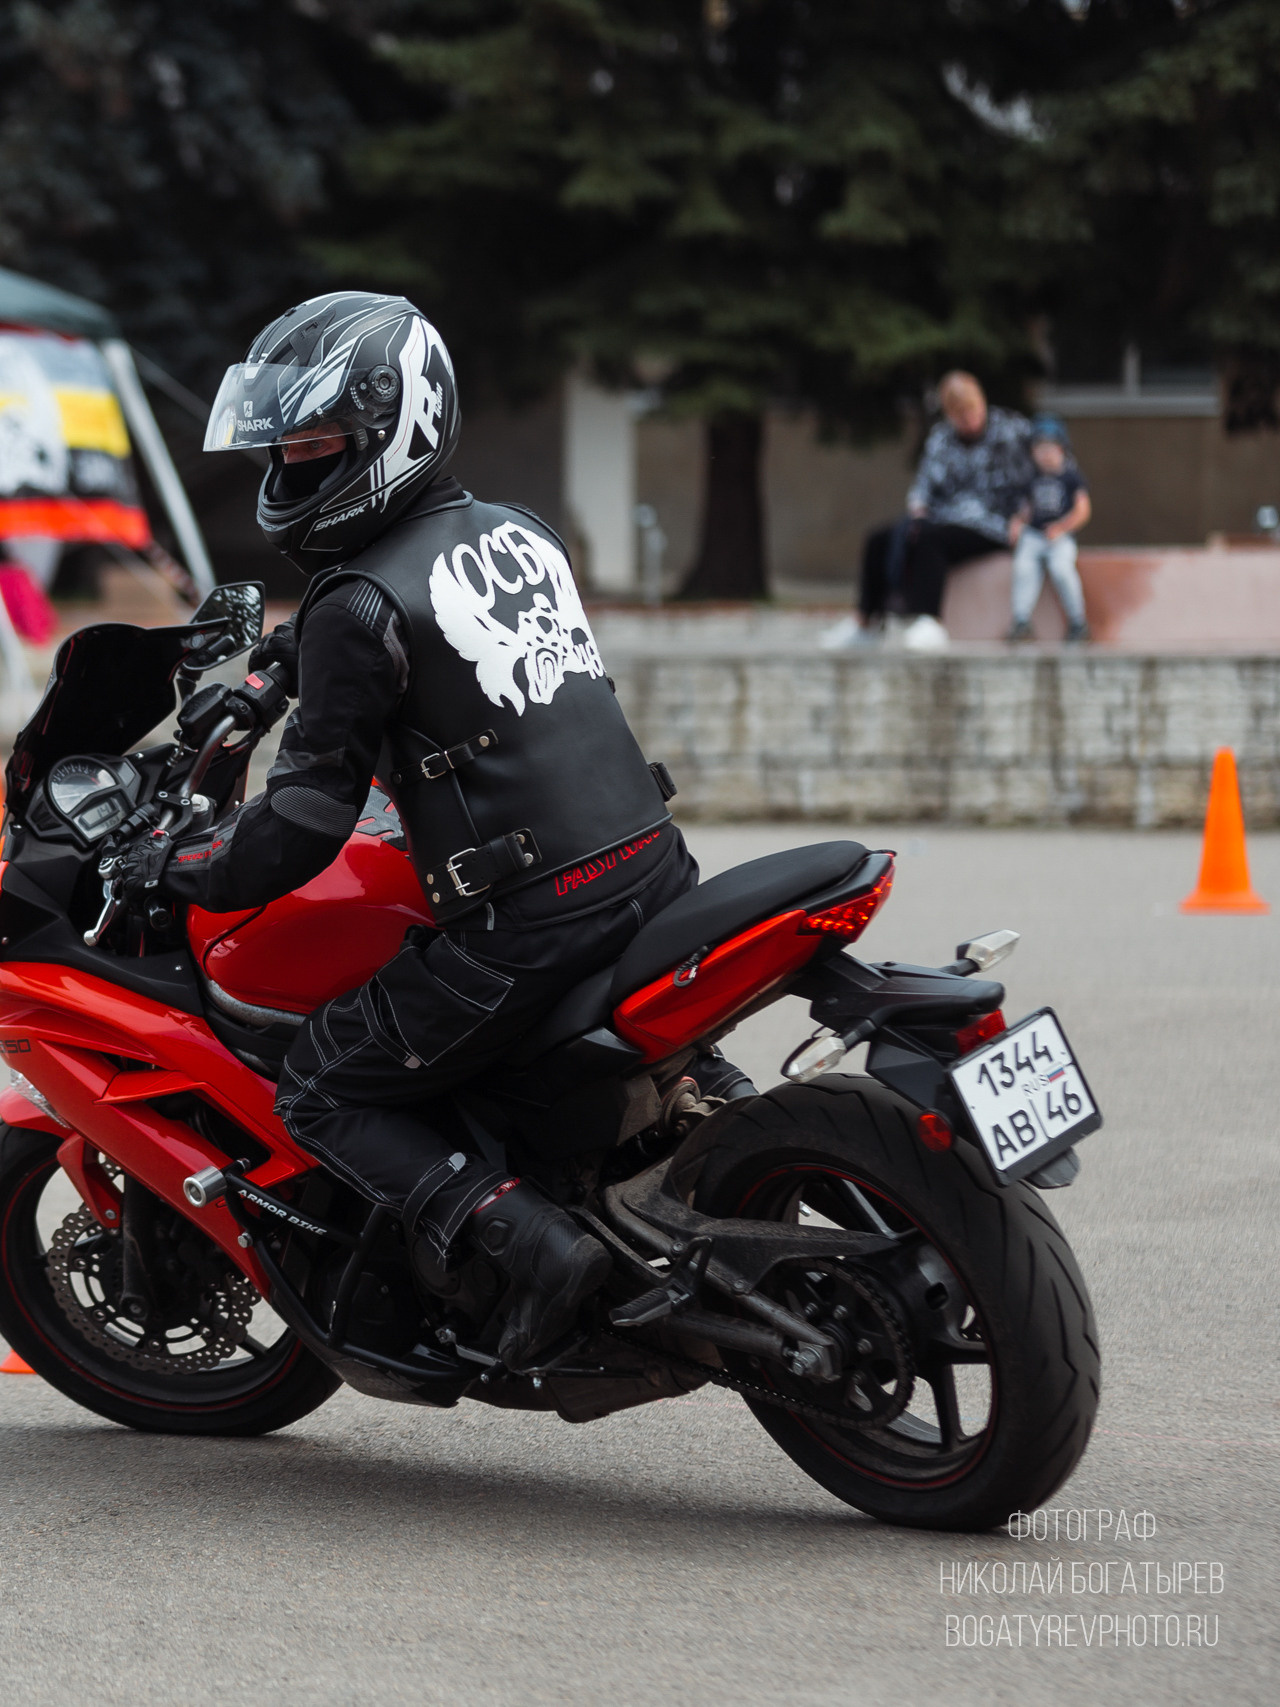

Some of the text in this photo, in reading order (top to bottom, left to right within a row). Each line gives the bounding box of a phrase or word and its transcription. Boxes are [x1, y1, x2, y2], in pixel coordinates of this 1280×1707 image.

[236, 416, 275, 432] SHARK
[313, 502, 369, 532] SHARK
[977, 1031, 1054, 1097] 1344
[1022, 1073, 1050, 1096] RUS
[1046, 1081, 1082, 1122] 46
[238, 1189, 327, 1236] ARMOR BIKE
